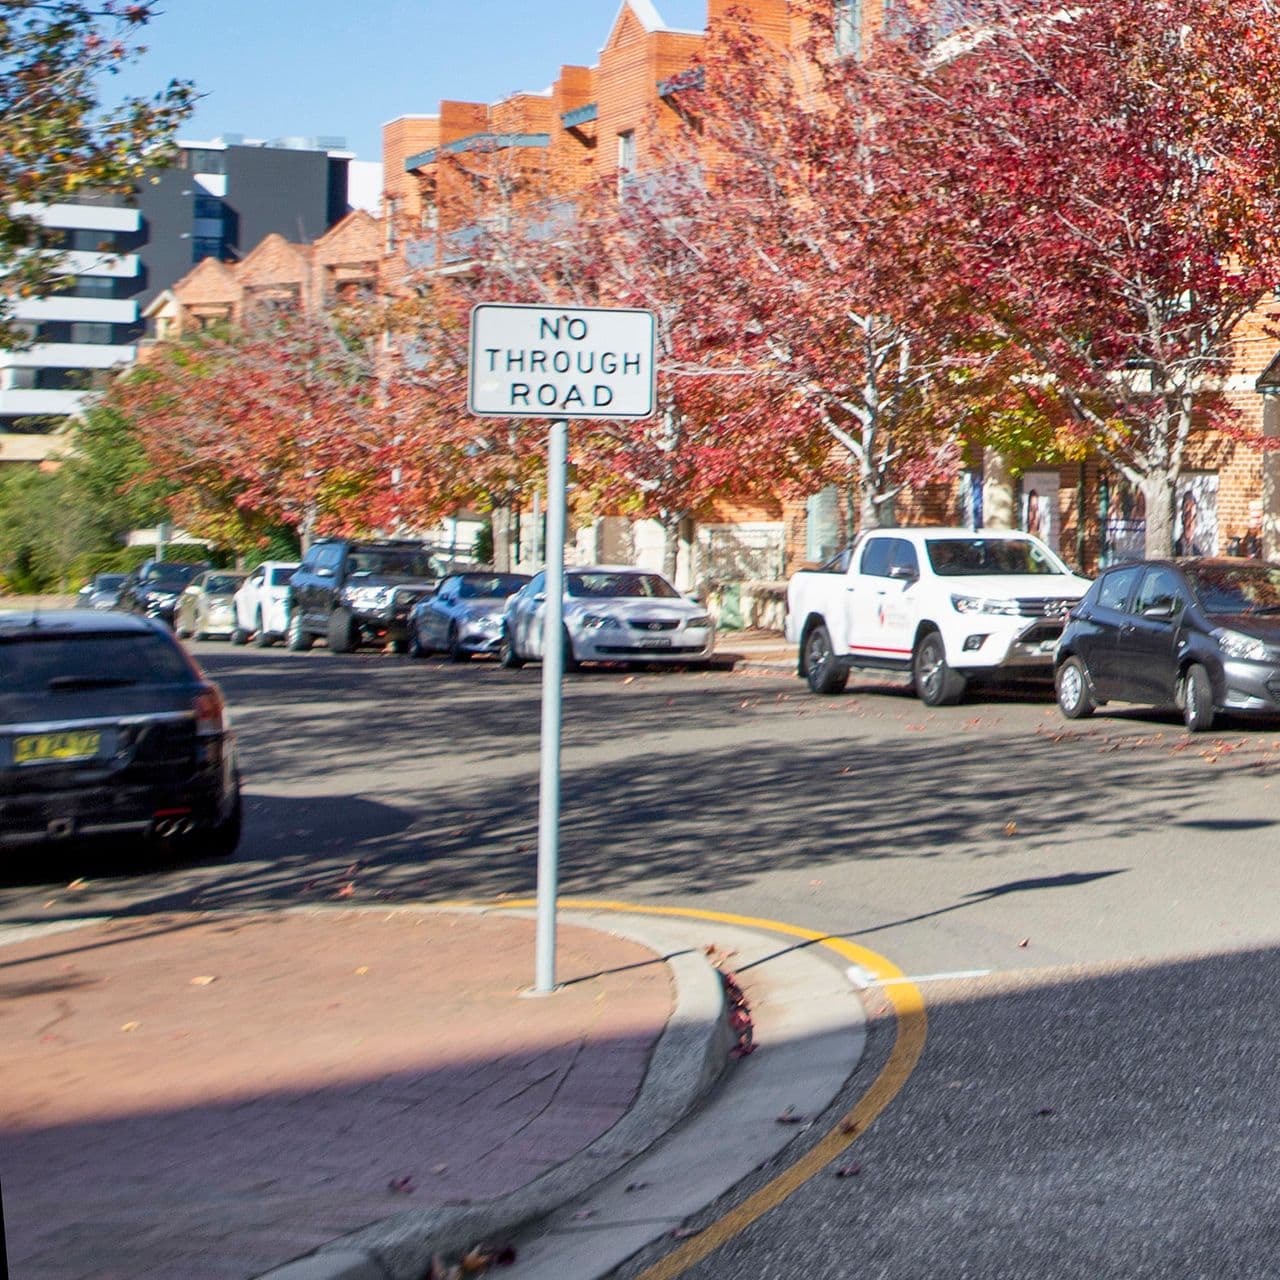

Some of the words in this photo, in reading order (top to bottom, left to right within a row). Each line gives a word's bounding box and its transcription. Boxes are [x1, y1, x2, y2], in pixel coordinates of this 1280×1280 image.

[540, 317, 588, 340] NO
[485, 348, 641, 375] THROUGH
[511, 383, 613, 407] ROAD
